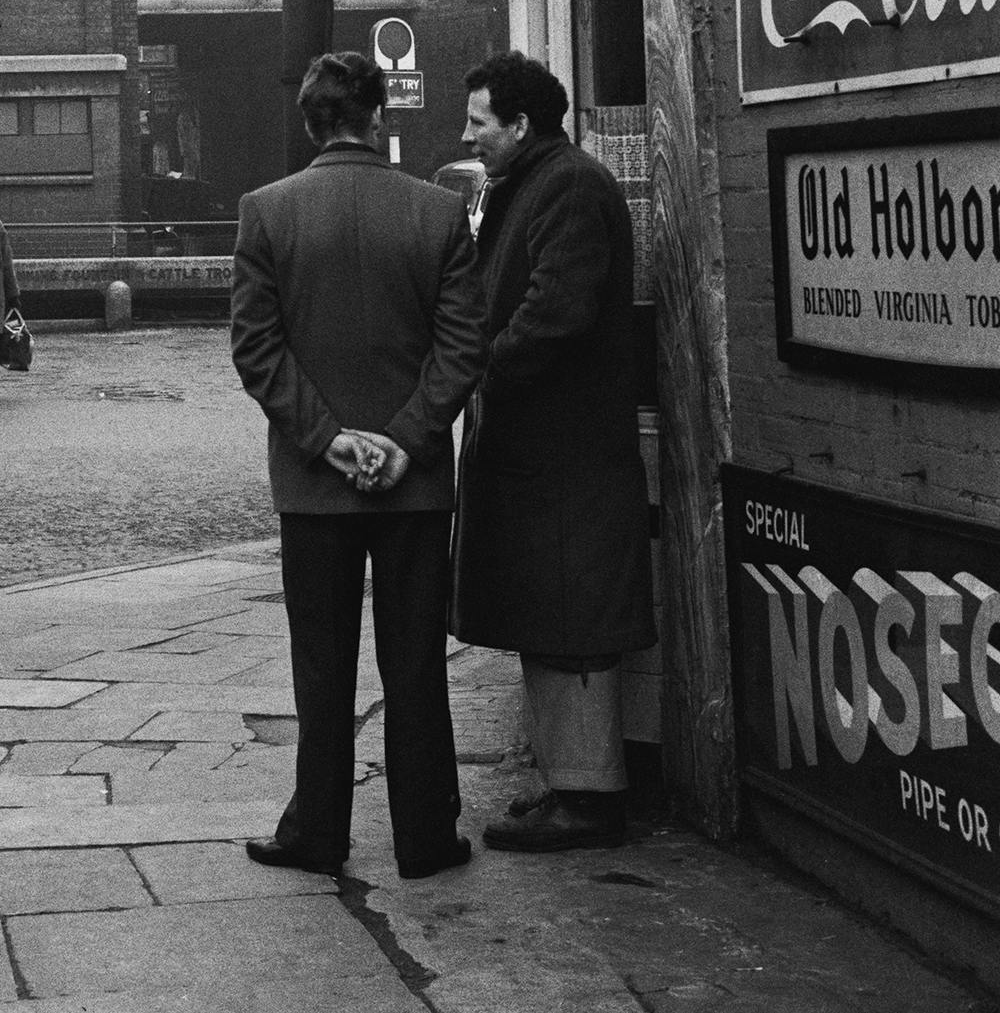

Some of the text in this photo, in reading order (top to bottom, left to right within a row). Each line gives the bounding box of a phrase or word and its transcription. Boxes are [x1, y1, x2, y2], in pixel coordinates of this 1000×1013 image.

[798, 163, 855, 261] Old
[803, 287, 862, 318] BLENDED
[873, 291, 953, 326] VIRGINIA
[745, 499, 810, 551] SPECIAL
[900, 769, 993, 853] PIPE OR
